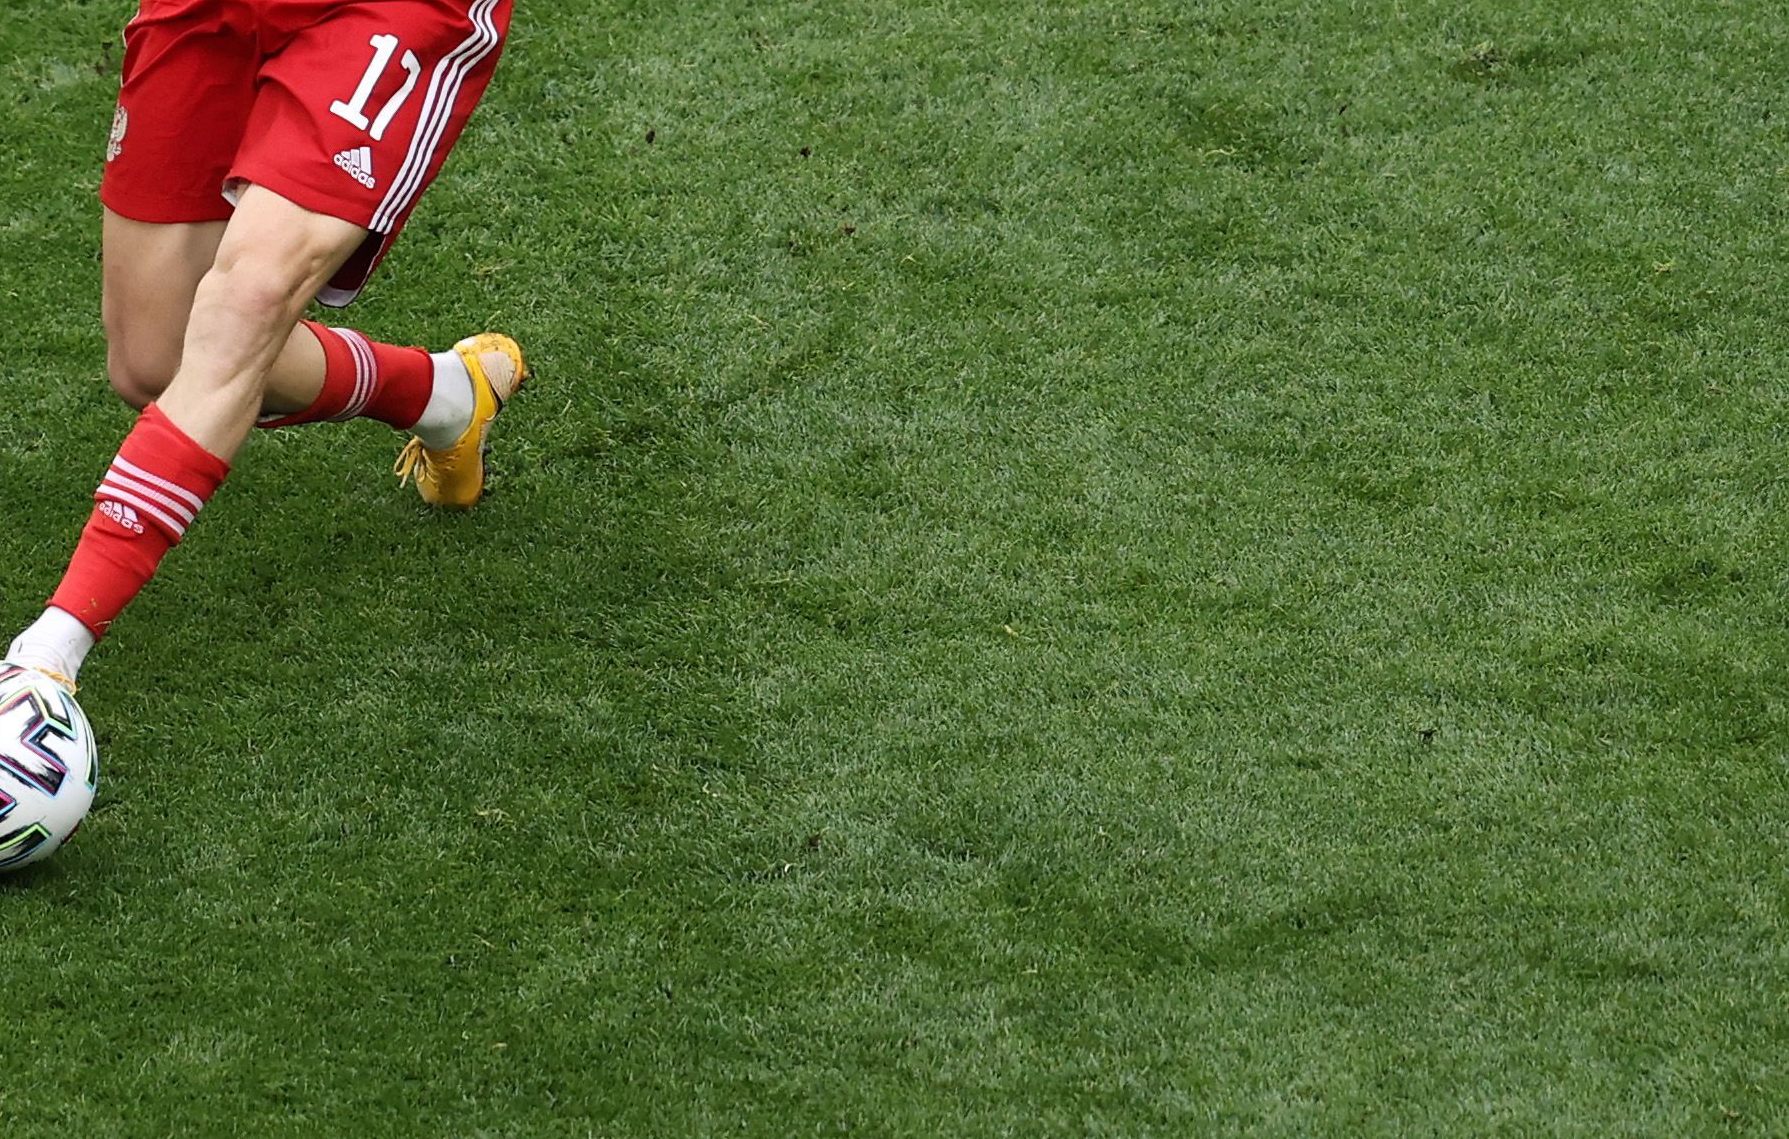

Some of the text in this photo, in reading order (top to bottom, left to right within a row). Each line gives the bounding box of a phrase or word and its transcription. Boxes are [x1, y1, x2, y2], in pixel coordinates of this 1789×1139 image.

[329, 33, 422, 142] 17
[333, 153, 376, 189] adidas
[98, 501, 144, 534] adidas
